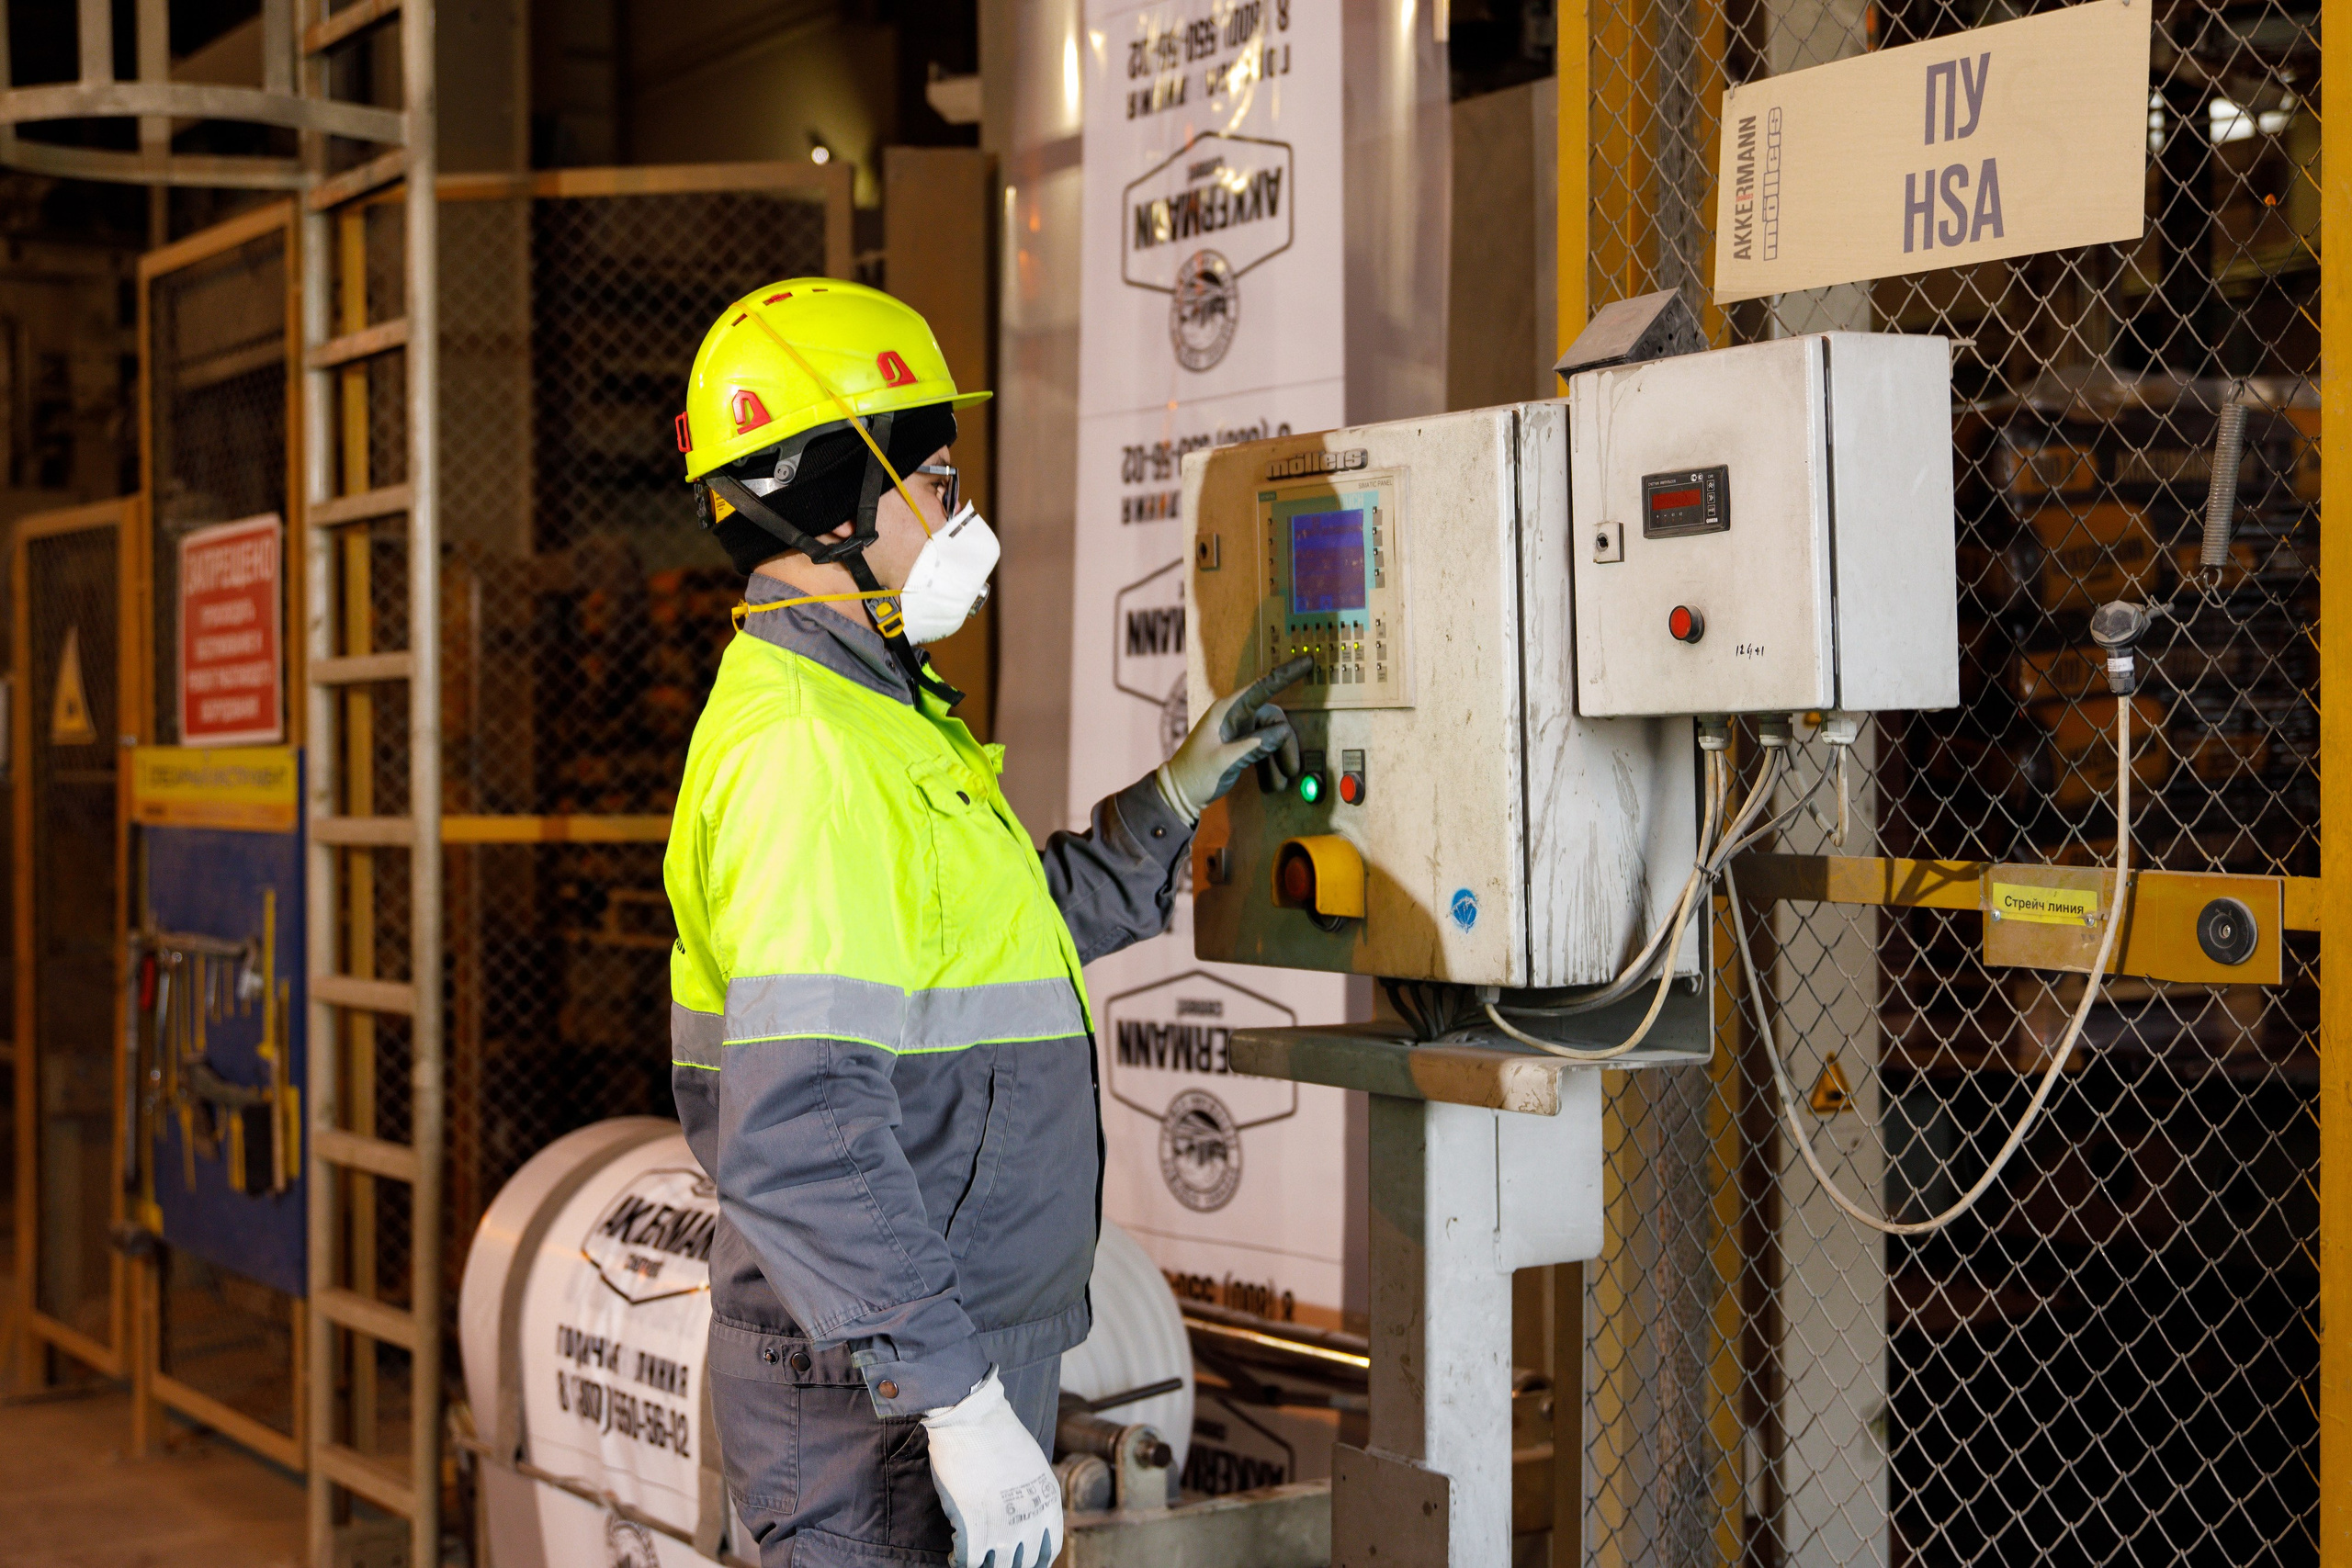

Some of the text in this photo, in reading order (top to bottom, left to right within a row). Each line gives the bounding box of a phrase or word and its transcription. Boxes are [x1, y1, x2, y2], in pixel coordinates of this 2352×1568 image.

[1925, 52, 1991, 145] ПУ
[1733, 115, 1757, 261] AKKERMANN
[1904, 158, 2005, 254] HSA
[1358, 479, 1393, 490] SIMATIC PANEL
[2004, 895, 2084, 915] Стрейч линия
